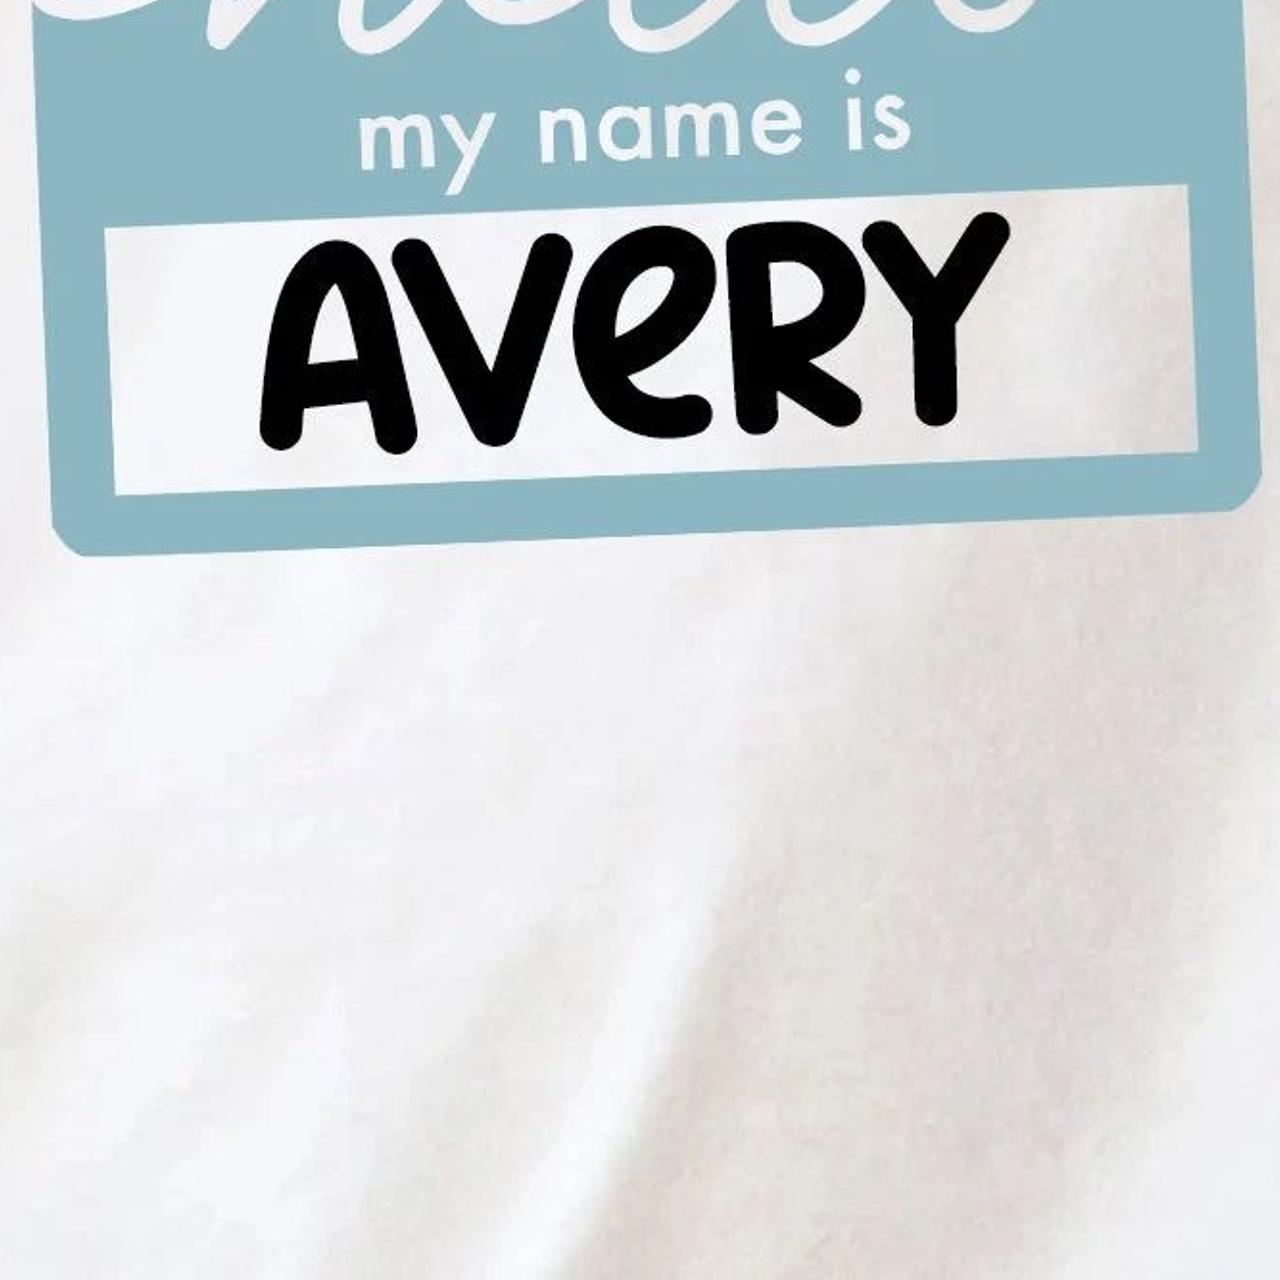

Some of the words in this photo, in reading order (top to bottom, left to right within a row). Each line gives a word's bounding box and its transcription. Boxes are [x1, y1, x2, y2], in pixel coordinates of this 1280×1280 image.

[358, 110, 497, 196] my
[537, 96, 804, 165] name
[844, 67, 912, 153] is
